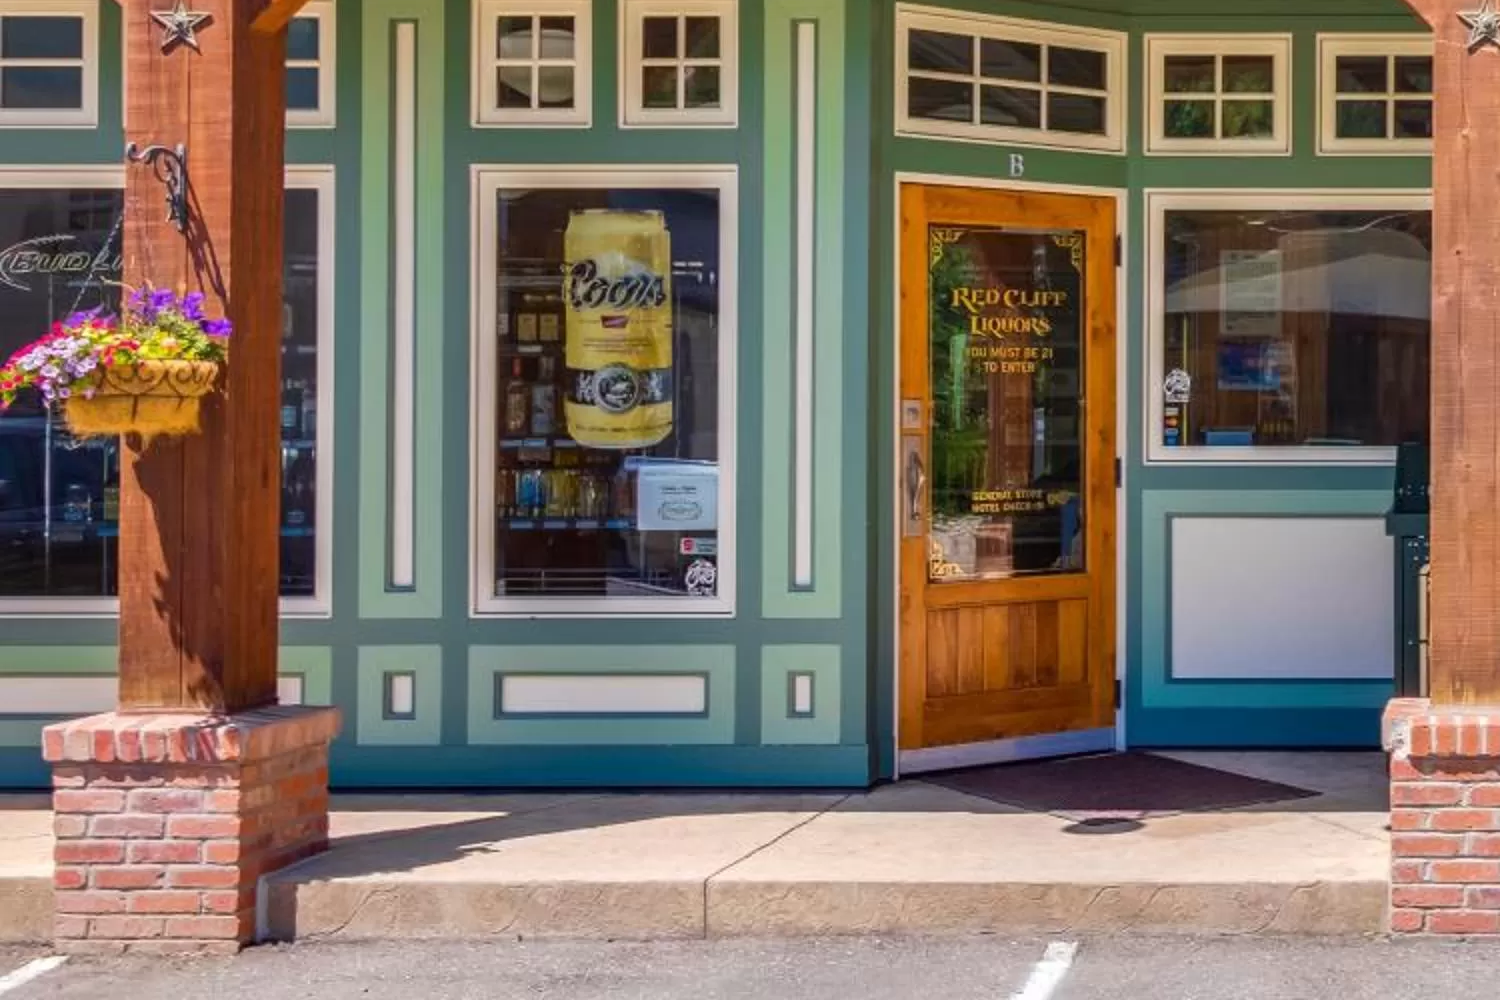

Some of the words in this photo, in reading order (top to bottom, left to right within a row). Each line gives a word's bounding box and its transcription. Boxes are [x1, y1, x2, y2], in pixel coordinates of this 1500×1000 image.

[1008, 153, 1025, 178] B
[561, 258, 667, 312] Coors
[970, 315, 1052, 339] LIQUORS
[989, 347, 1021, 358] MUST
[1023, 347, 1040, 359] BE
[1042, 347, 1054, 359] 21
[983, 361, 999, 373] TO
[1001, 361, 1036, 373] ENTER
